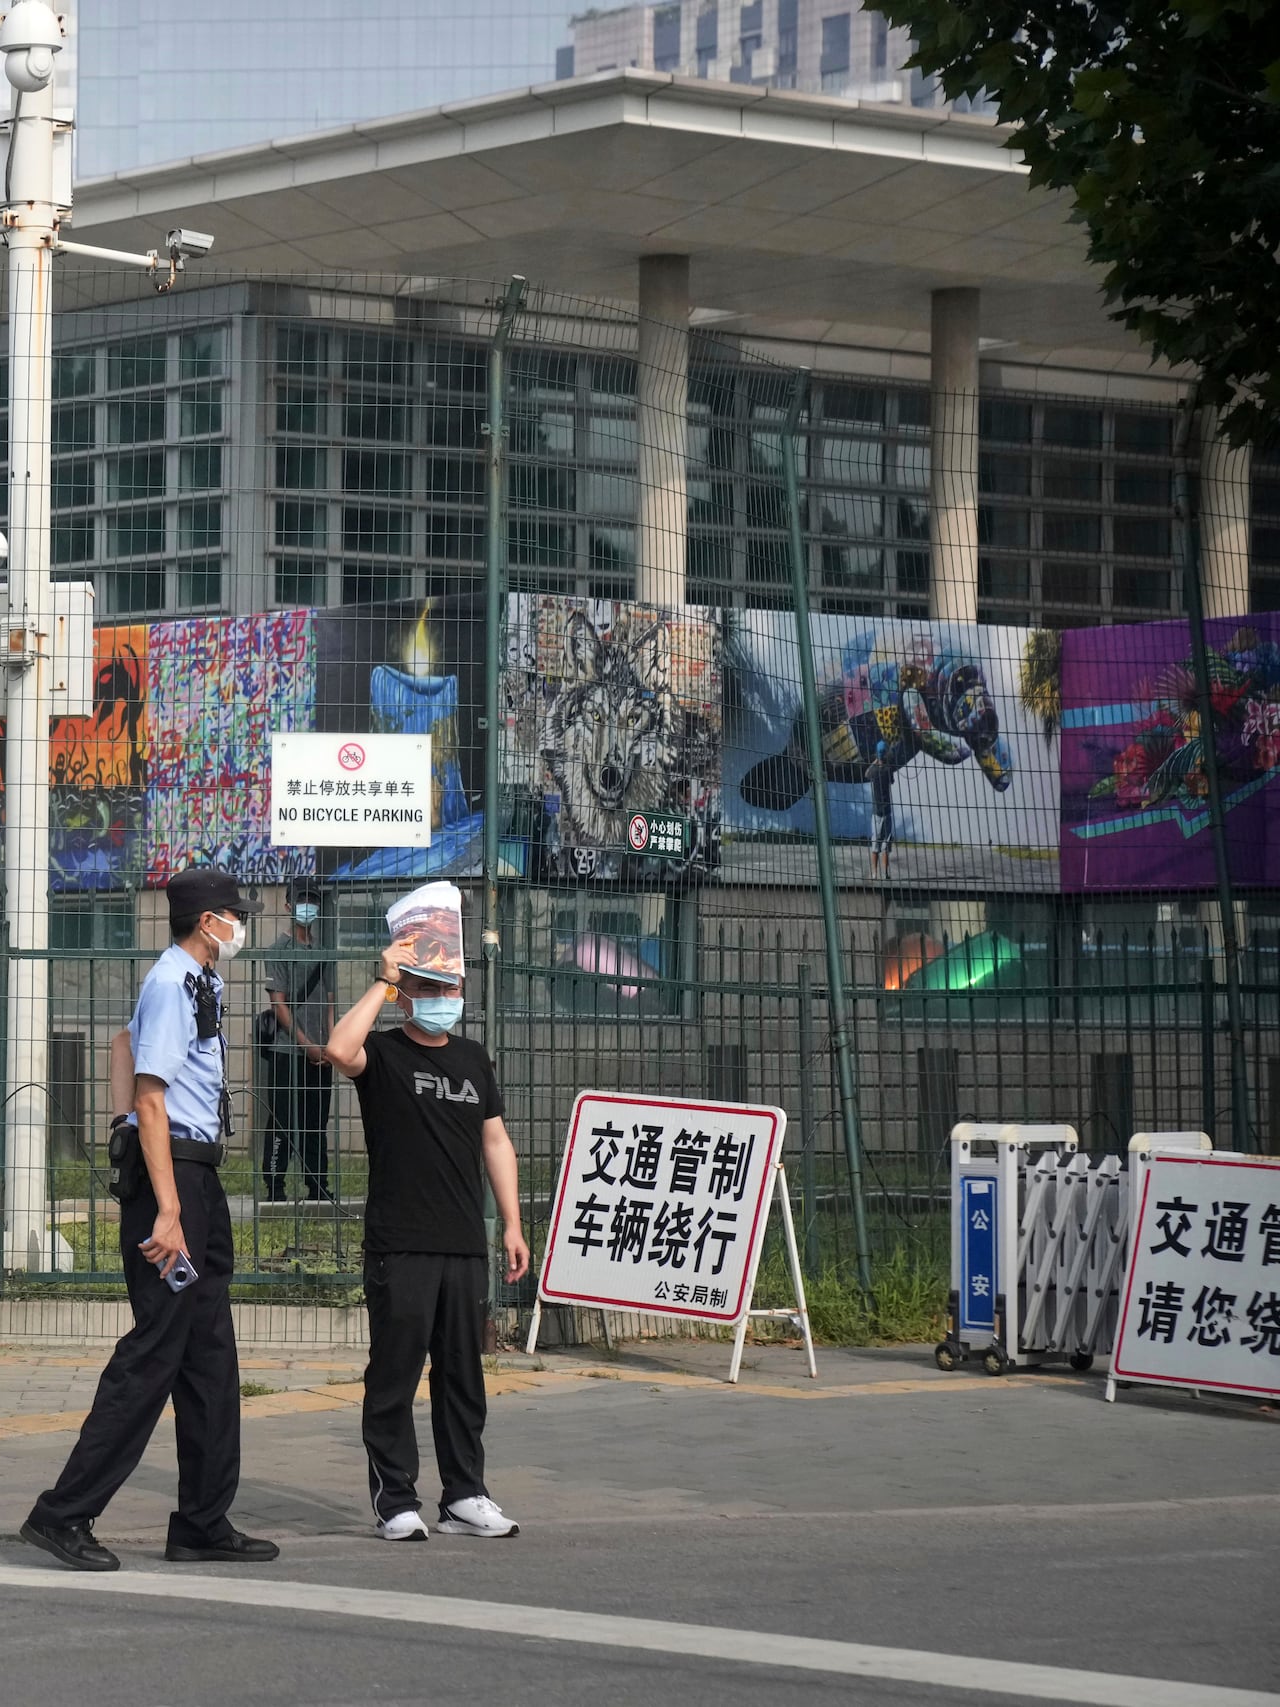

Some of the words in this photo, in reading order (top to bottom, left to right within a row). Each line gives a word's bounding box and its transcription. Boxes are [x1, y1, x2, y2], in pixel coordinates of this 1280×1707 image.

[287, 780, 415, 797] 禁止停放共享单车
[279, 807, 297, 821] NO
[303, 808, 358, 822] BICYCLE
[364, 808, 423, 822] PARKING
[650, 819, 682, 836] 小心划伤
[413, 1071, 480, 1104] FILA
[582, 1121, 755, 1201] 交通管制
[568, 1192, 738, 1275] 车辆绕行
[971, 1208, 990, 1297] 公安
[654, 1280, 728, 1308] 公安局制
[1137, 1281, 1280, 1355] 请您绕
